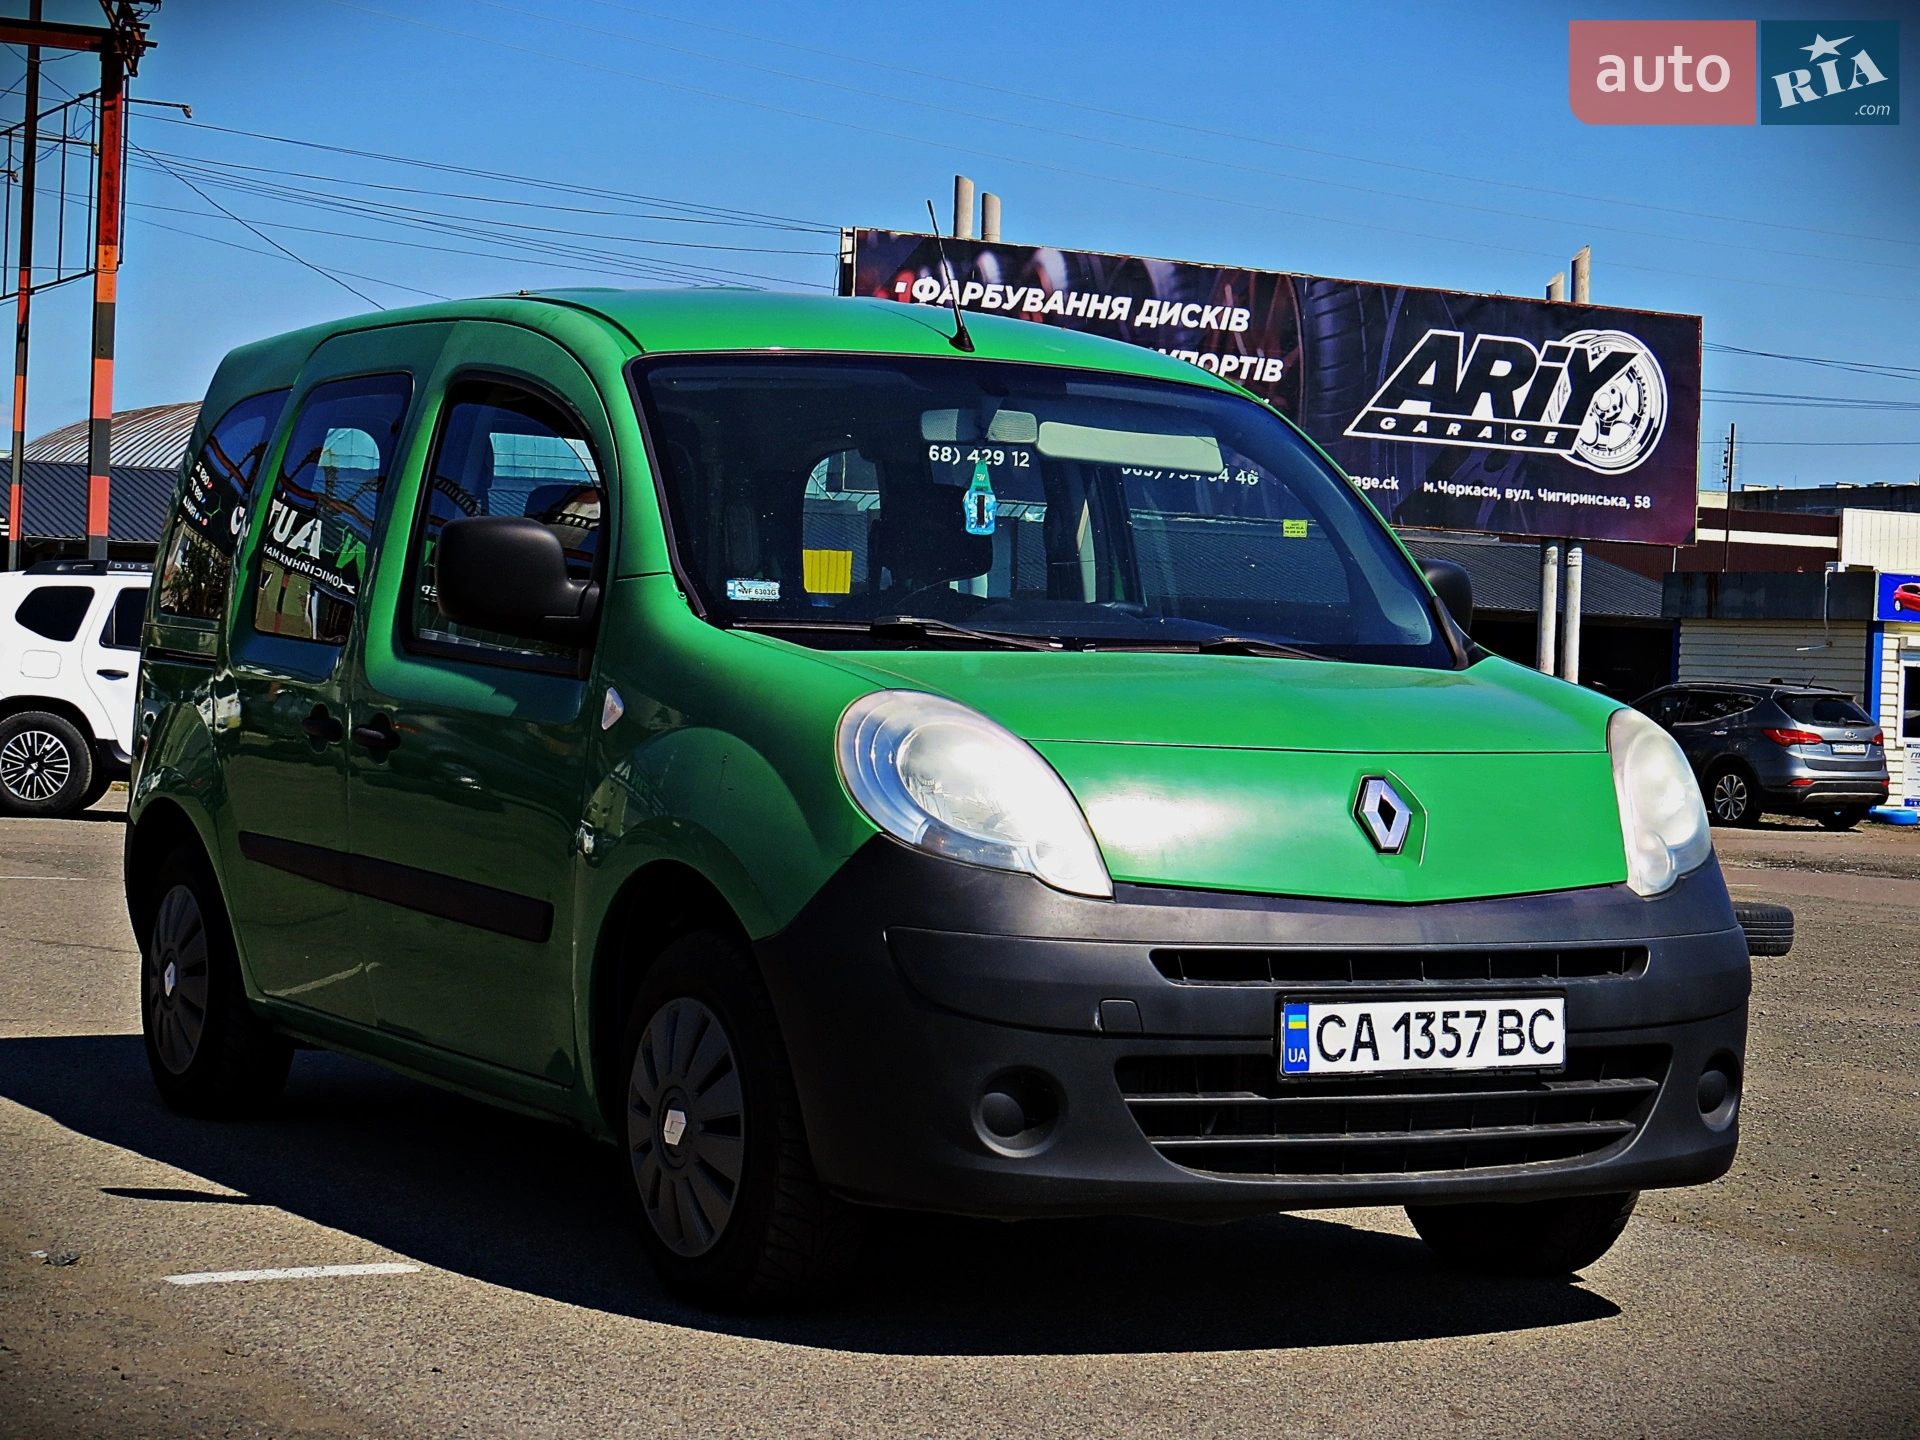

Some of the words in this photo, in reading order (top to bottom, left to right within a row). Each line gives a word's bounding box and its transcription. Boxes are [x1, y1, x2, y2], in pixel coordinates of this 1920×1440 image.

[911, 276, 1133, 321] ФАРБУВАННЯ
[1134, 299, 1251, 333] ДИСКІВ
[1379, 416, 1559, 445] GARAGE
[966, 449, 1005, 466] 429
[1012, 451, 1030, 468] 12
[1423, 480, 1502, 501] м.Черкаси,
[1505, 488, 1534, 501] вул.
[1537, 488, 1630, 510] Чигиринська,
[1634, 495, 1651, 509] 58
[1288, 1048, 1307, 1063] UA
[1316, 1013, 1379, 1062] CA
[1392, 1010, 1487, 1060] 1357
[1498, 1008, 1555, 1056] BC
